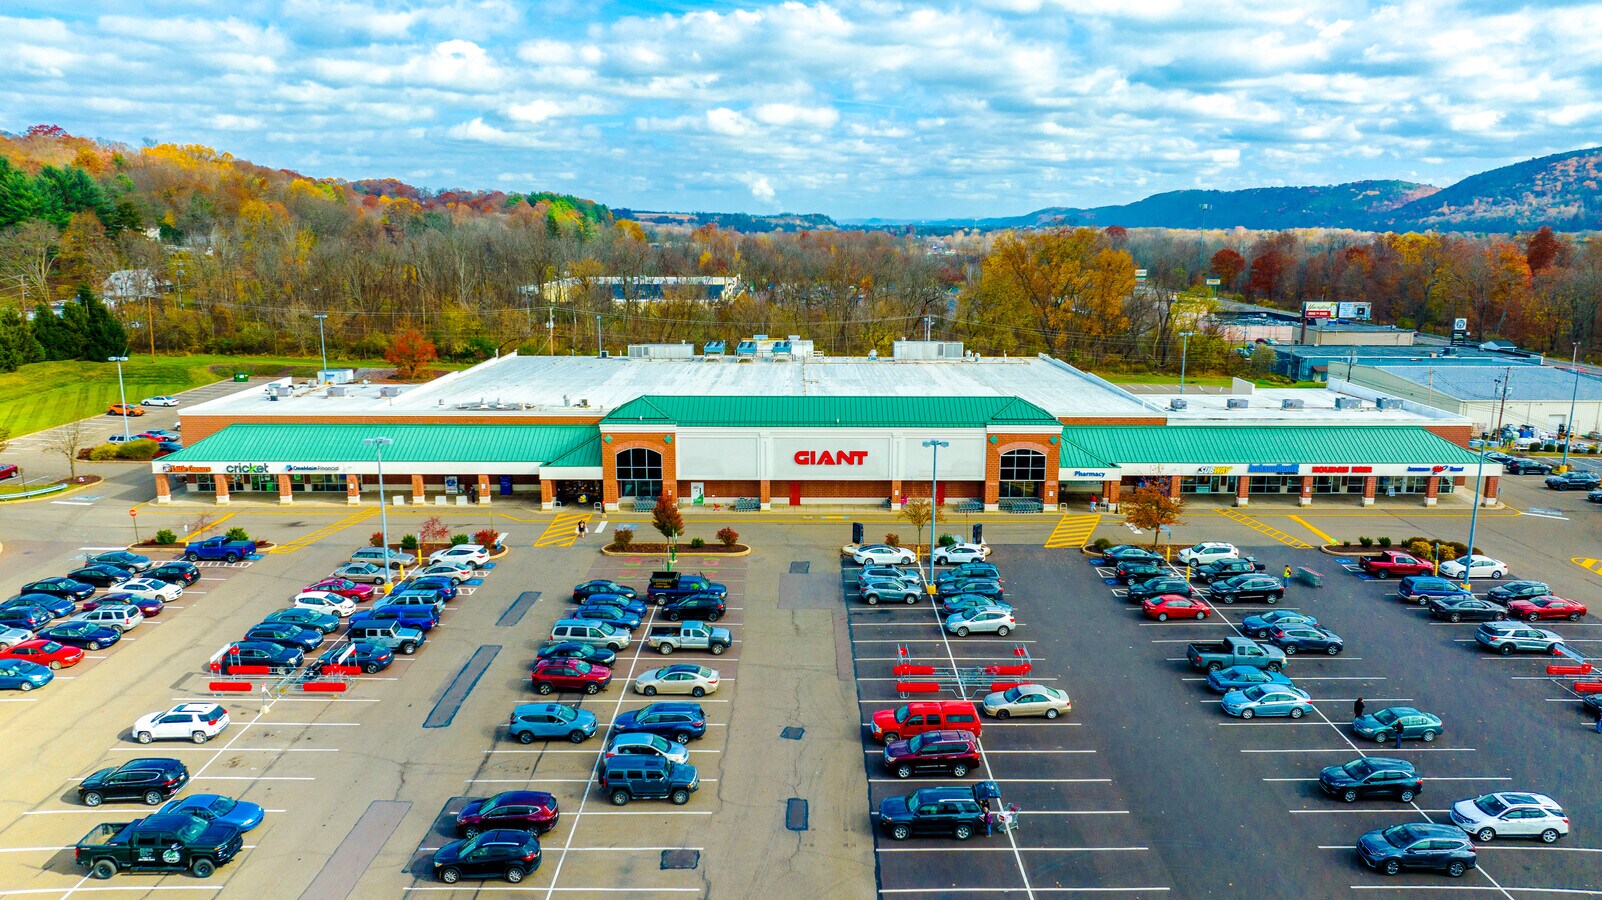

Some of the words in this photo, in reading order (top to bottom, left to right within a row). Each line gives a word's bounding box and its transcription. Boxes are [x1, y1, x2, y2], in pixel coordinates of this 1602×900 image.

[794, 450, 868, 465] GIANT
[226, 463, 269, 473] cricket
[1198, 466, 1232, 474] SUBWAY
[1074, 470, 1105, 479] Pharmacy
